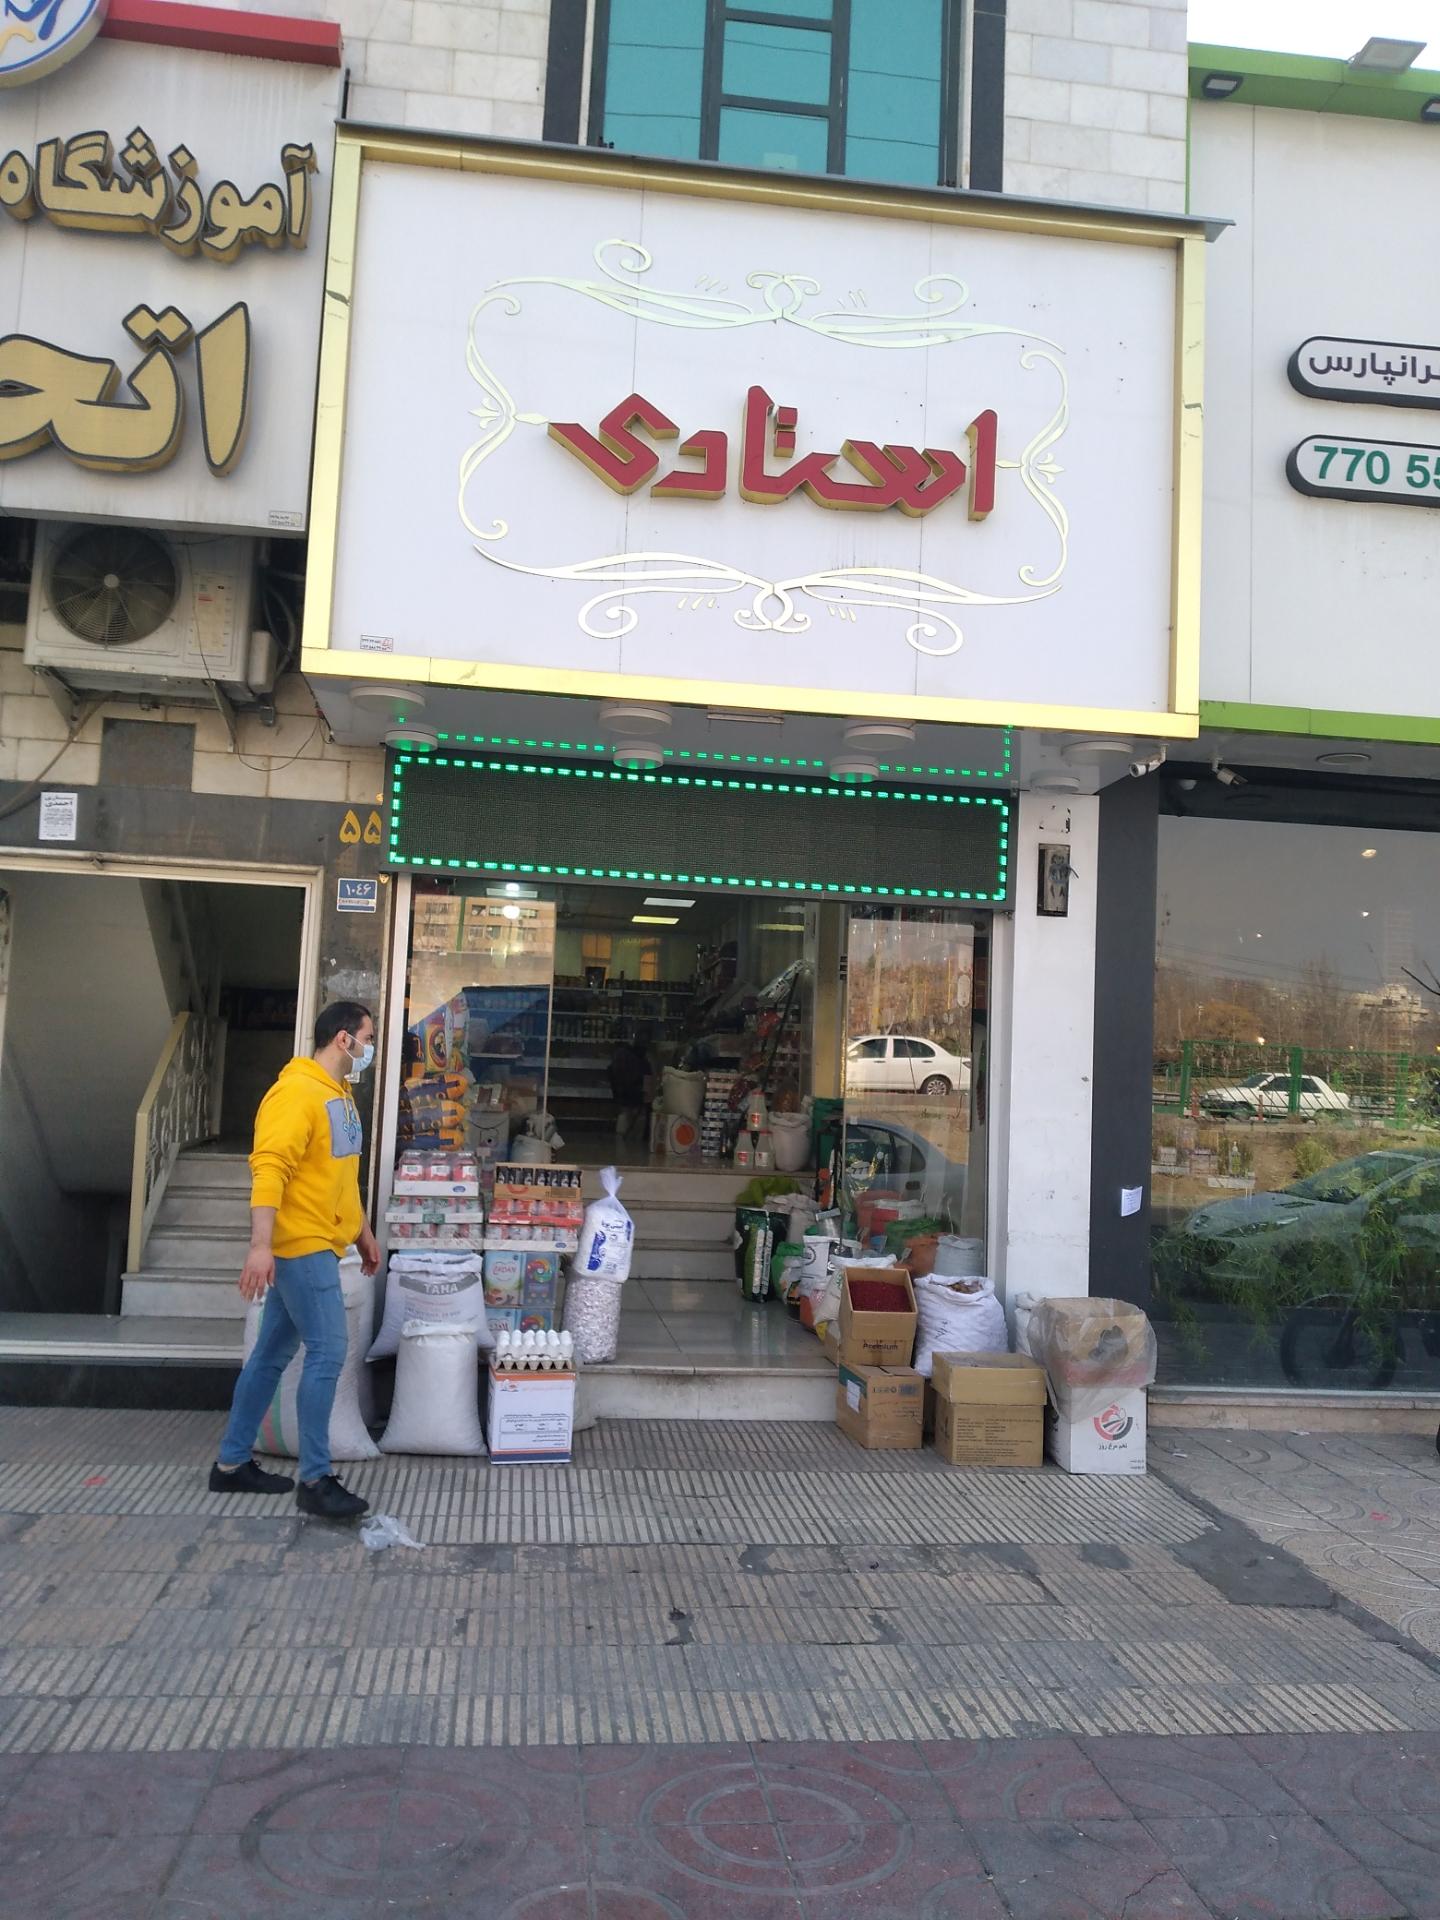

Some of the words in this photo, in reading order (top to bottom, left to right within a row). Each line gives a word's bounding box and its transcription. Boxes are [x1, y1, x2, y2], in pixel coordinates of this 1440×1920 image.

[0, 126, 320, 265] آموزشگاه
[547, 385, 998, 521] استادی
[1313, 445, 1391, 485] 770
[423, 1282, 459, 1295] TAHA
